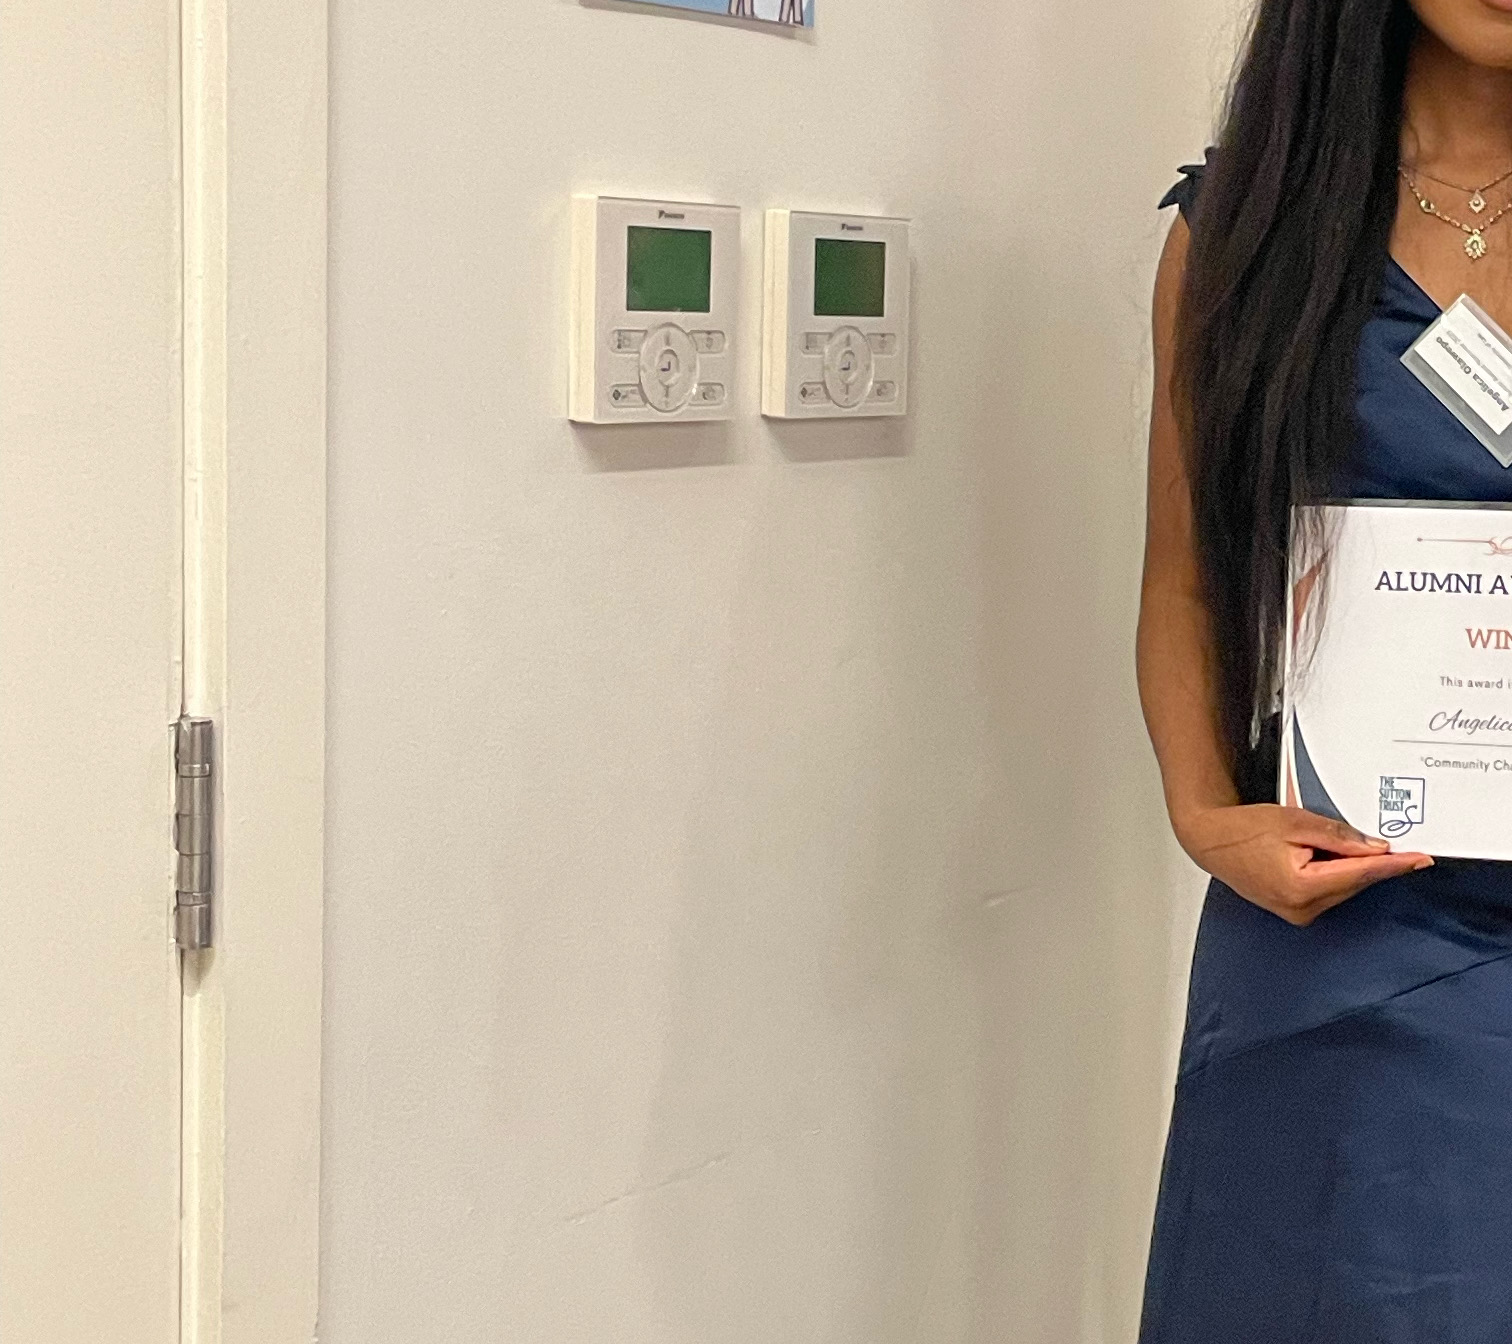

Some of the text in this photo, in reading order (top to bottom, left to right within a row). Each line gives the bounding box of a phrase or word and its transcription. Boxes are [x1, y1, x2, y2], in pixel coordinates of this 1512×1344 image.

[1375, 570, 1482, 595] ALUMNI
[1440, 676, 1463, 688] This
[1467, 677, 1504, 690] award
[1379, 788, 1412, 801] SUTTON
[1379, 798, 1405, 812] TRUST
